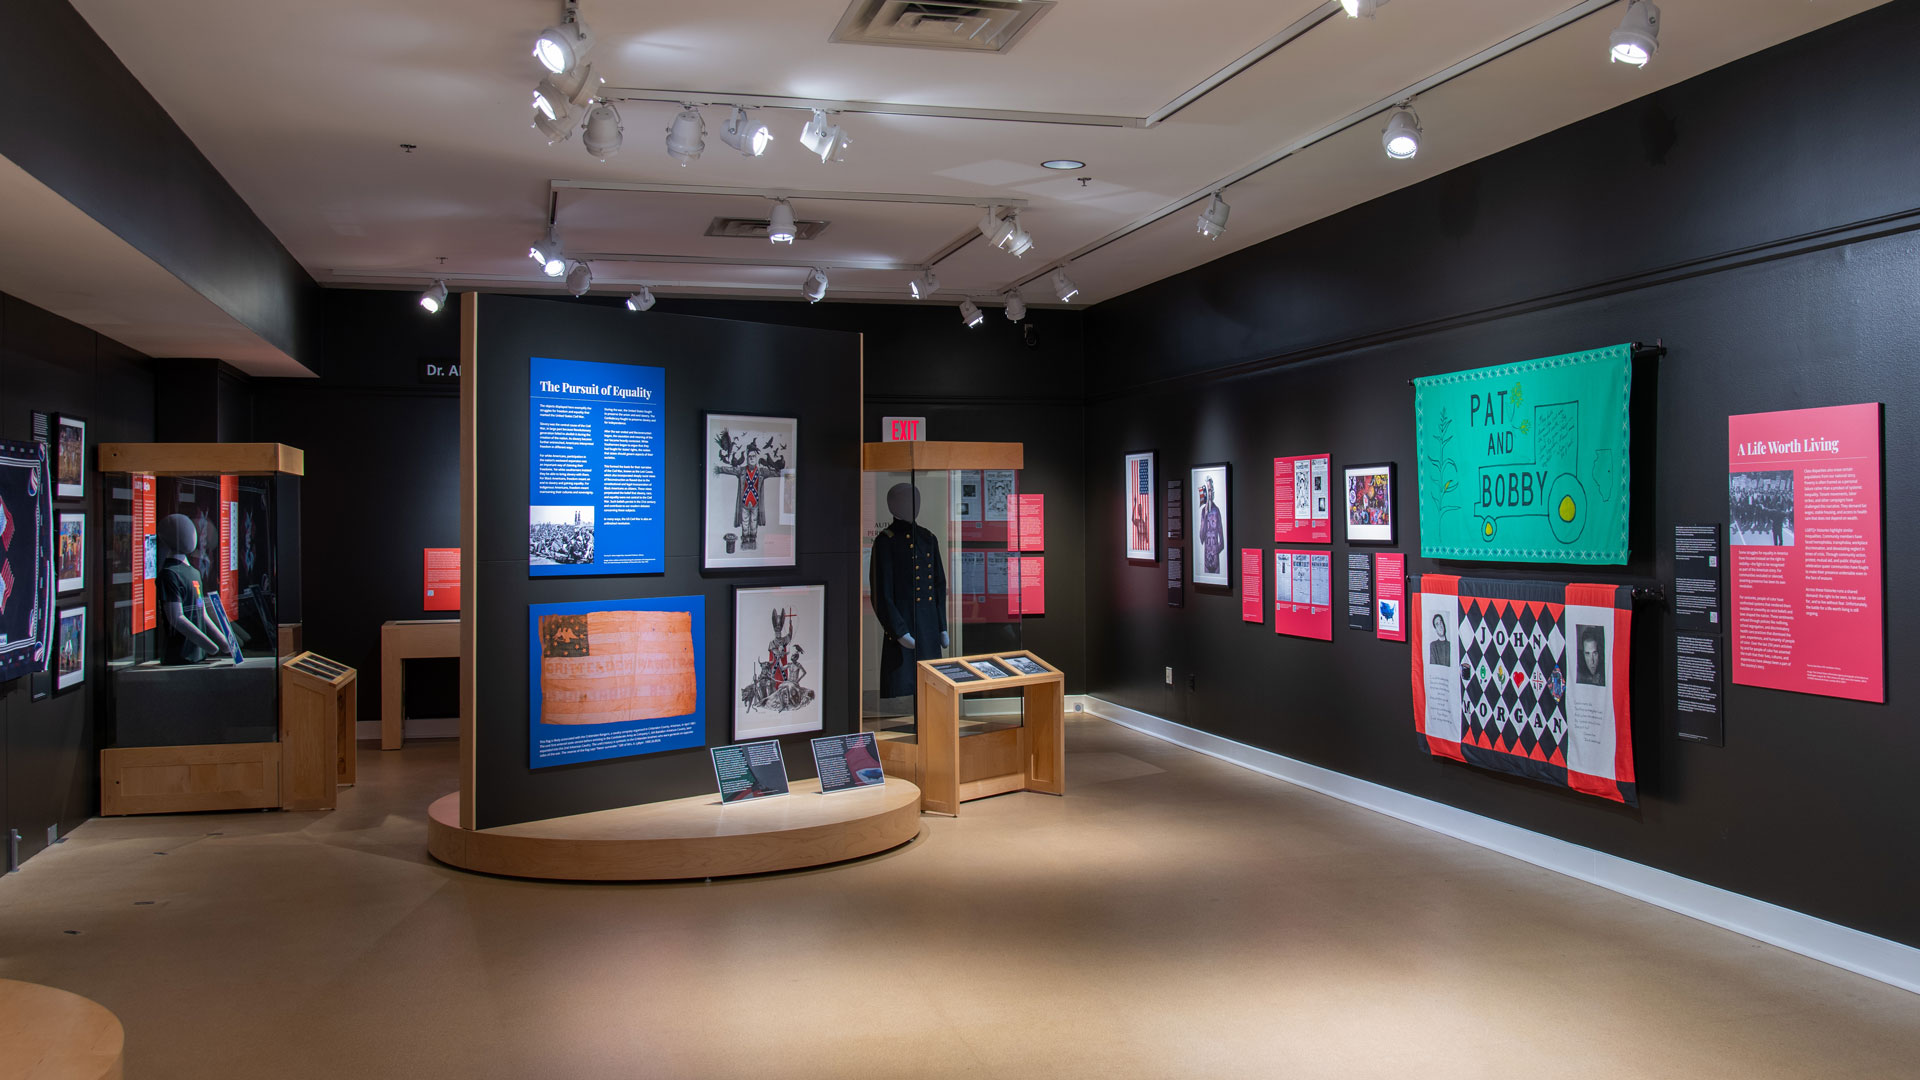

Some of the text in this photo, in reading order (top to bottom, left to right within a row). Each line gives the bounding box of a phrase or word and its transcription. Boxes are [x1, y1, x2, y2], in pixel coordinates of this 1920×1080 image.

[427, 364, 445, 376] Dr.
[539, 380, 652, 400] The Pursuit of Equality
[1470, 390, 1507, 427] PAT
[891, 420, 919, 441] EXIT
[1488, 431, 1513, 456] AND
[1737, 437, 1839, 456] A Life Worth Living
[1482, 471, 1548, 508] BOBBY
[1480, 627, 1541, 650] JOHN
[1463, 700, 1562, 734] MORGAN
